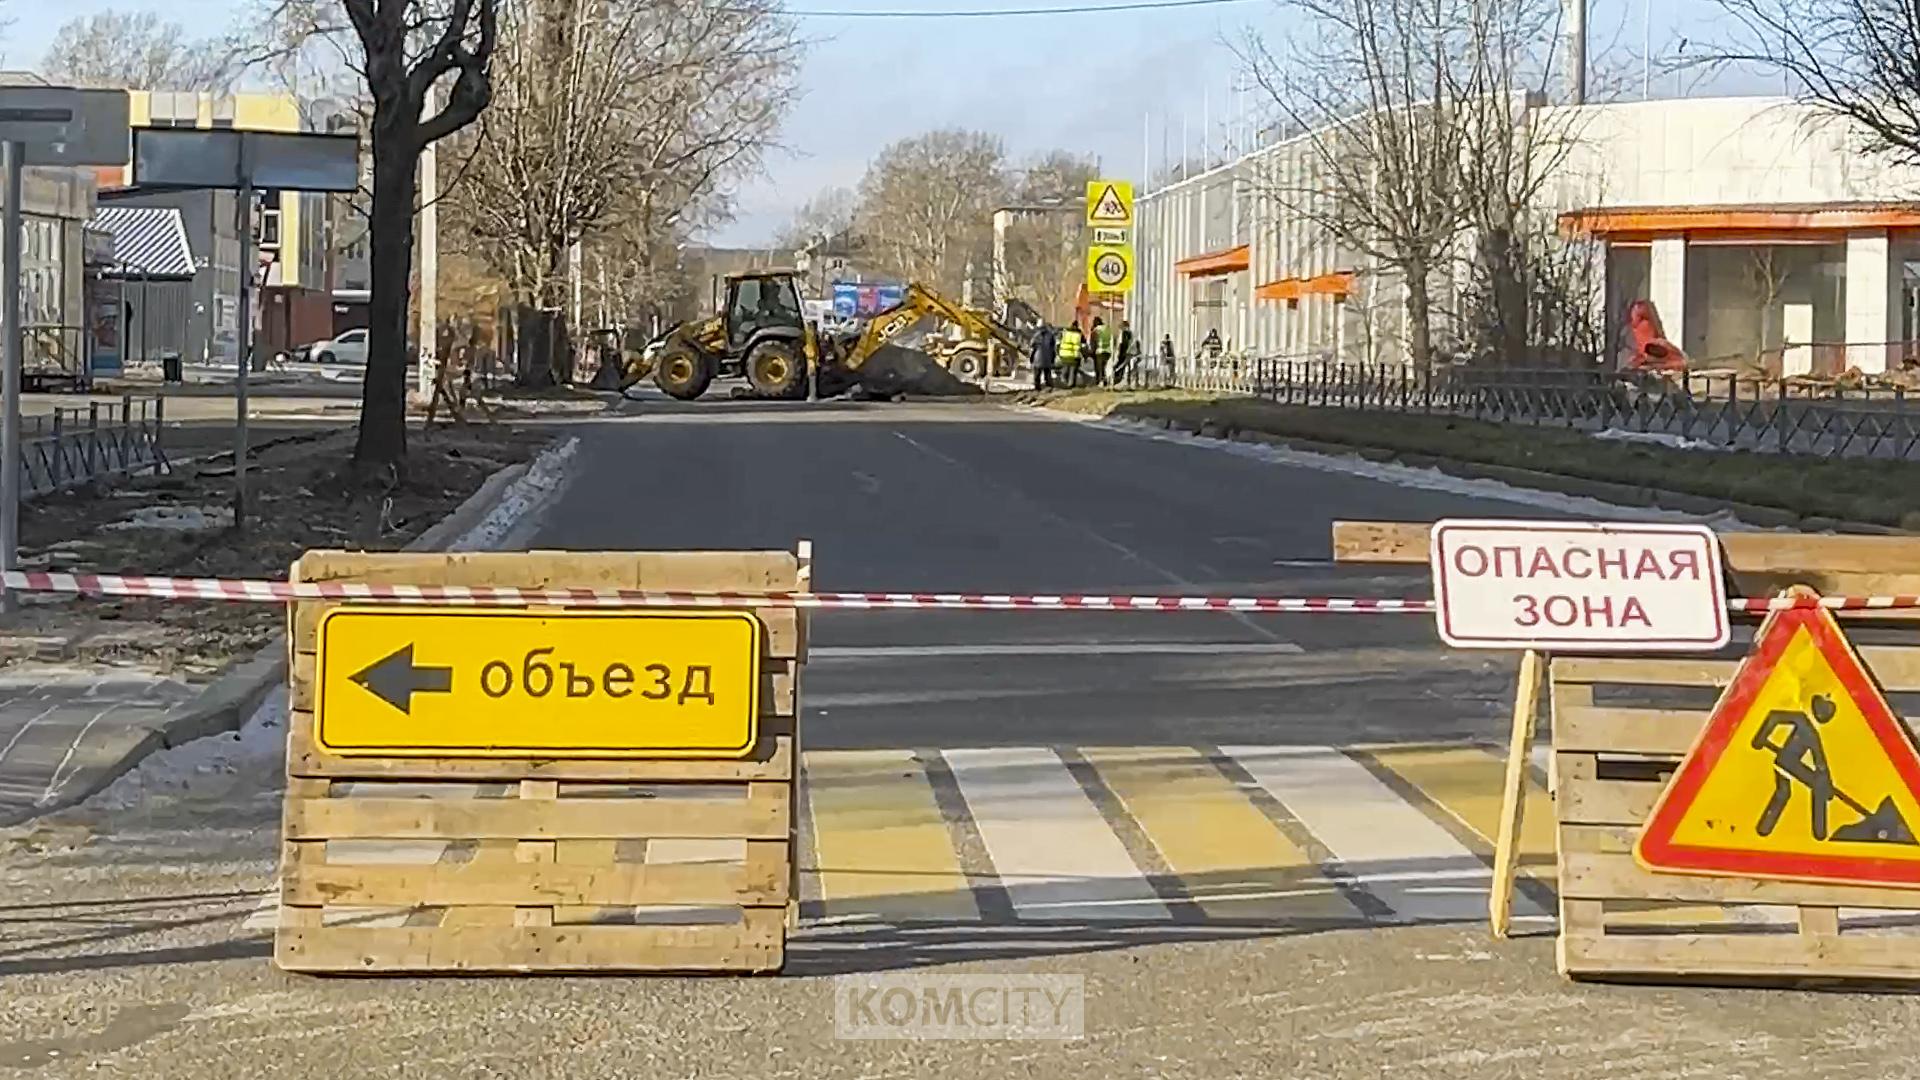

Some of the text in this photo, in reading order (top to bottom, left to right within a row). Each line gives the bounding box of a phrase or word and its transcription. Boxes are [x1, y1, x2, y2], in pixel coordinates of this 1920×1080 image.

[1101, 262, 1121, 276] 40
[877, 315, 908, 342] JCB
[1454, 544, 1701, 581] ОПАСНАЯ
[1512, 594, 1653, 628] ЗОНА
[480, 646, 715, 706] объезд
